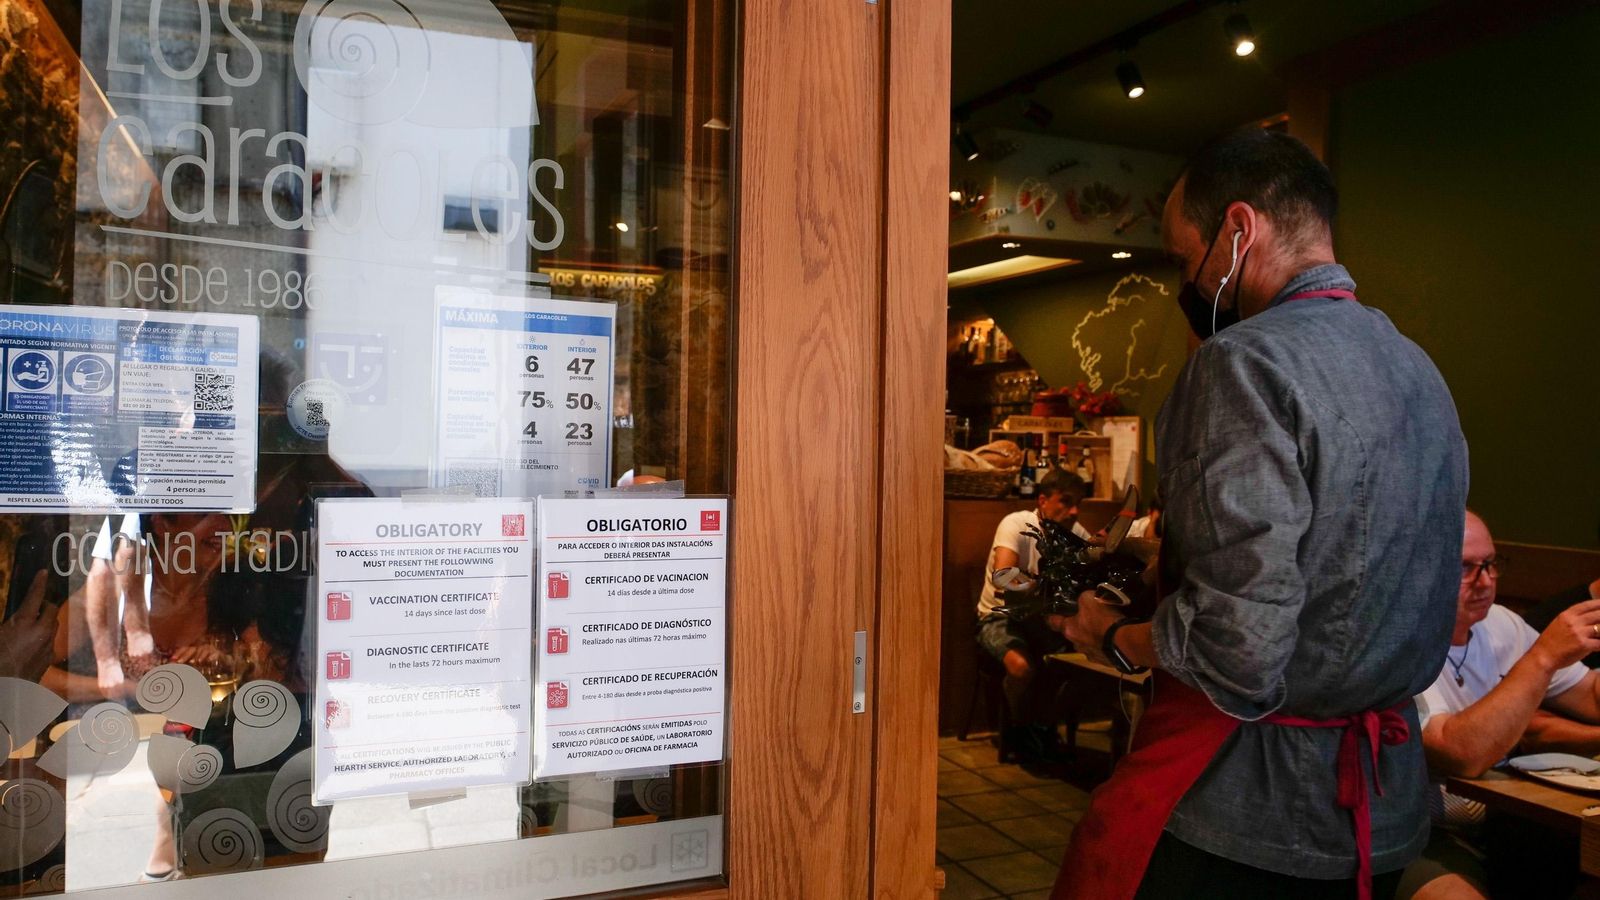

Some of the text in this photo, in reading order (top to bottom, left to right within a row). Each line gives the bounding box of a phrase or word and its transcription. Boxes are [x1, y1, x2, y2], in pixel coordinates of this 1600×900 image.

[106, 0, 262, 87] LOS
[550, 272, 575, 287] LOS
[242, 269, 325, 310] 1986
[446, 309, 498, 324] MÁXIMA
[51, 341, 89, 349] NORMATIVA
[568, 346, 597, 354] INTERIOR
[525, 355, 595, 375] 6 47
[522, 421, 593, 440] 4 23
[376, 523, 483, 538] OBLIGATORY
[586, 518, 687, 532] OBLIGATORIO
[579, 542, 610, 550] ACCEDER
[619, 541, 650, 549] INTERIOR
[667, 539, 713, 548] INSTALACIÓNS
[336, 550, 347, 558] TO
[349, 549, 378, 557] ACCESS
[397, 548, 433, 556] INTERIOR
[447, 547, 462, 555] THE
[464, 546, 501, 555] FACILITIES
[503, 546, 519, 554] YOU
[604, 551, 671, 559] DEBERÁ PRESENTAR
[363, 560, 387, 568] MUST
[388, 559, 423, 567] PRESENT
[441, 557, 494, 566] FOLLOWWING
[394, 569, 464, 578] DOCUMENTATION
[585, 573, 709, 585] CERTIFICADO DE VACINACION
[369, 592, 500, 605] VACCINATION CERTIFICATE
[607, 589, 616, 597] 14
[617, 588, 631, 596] días
[632, 588, 651, 596] desde
[658, 587, 678, 595] última
[404, 607, 486, 619] 14 days since last dose
[582, 618, 712, 633] CERTIFICADO DE DIAGNÓSTICO
[582, 637, 614, 646] Realizado
[628, 635, 652, 644] últimas
[663, 633, 681, 642] horas
[682, 632, 707, 640] máximo
[367, 642, 489, 657] DIAGNOSTIC CERTIFICATE
[398, 661, 411, 669] the
[413, 660, 430, 668] lasts
[431, 659, 441, 667] 72
[443, 658, 463, 666] hours
[465, 657, 501, 665] maximum
[582, 668, 718, 686] CERTIFICADO DE RECUPERACIÓN
[368, 689, 481, 705] RECOVERY CERTIFICATE
[614, 691, 625, 699] días
[626, 690, 642, 698] desde
[648, 689, 662, 698] proba
[663, 687, 692, 696] diagnóstica
[693, 685, 712, 694] positiva
[587, 724, 641, 735] CERTIFICACIÓNS
[642, 722, 660, 731] SERÁN
[661, 720, 692, 729] EMITIDAS
[552, 740, 588, 749] SERVICIZO
[589, 736, 619, 747] PÚBLICO
[620, 736, 629, 744] DE
[631, 733, 655, 743] SAÚDE,
[666, 729, 713, 740] LABORATORIO
[567, 741, 698, 760] AUTORIZADO OU OFICINA DE FARMACIA
[334, 763, 367, 773] HEARTH
[403, 756, 452, 767] AUTHORIZED
[389, 766, 465, 780] PHARMACY OFFICES
